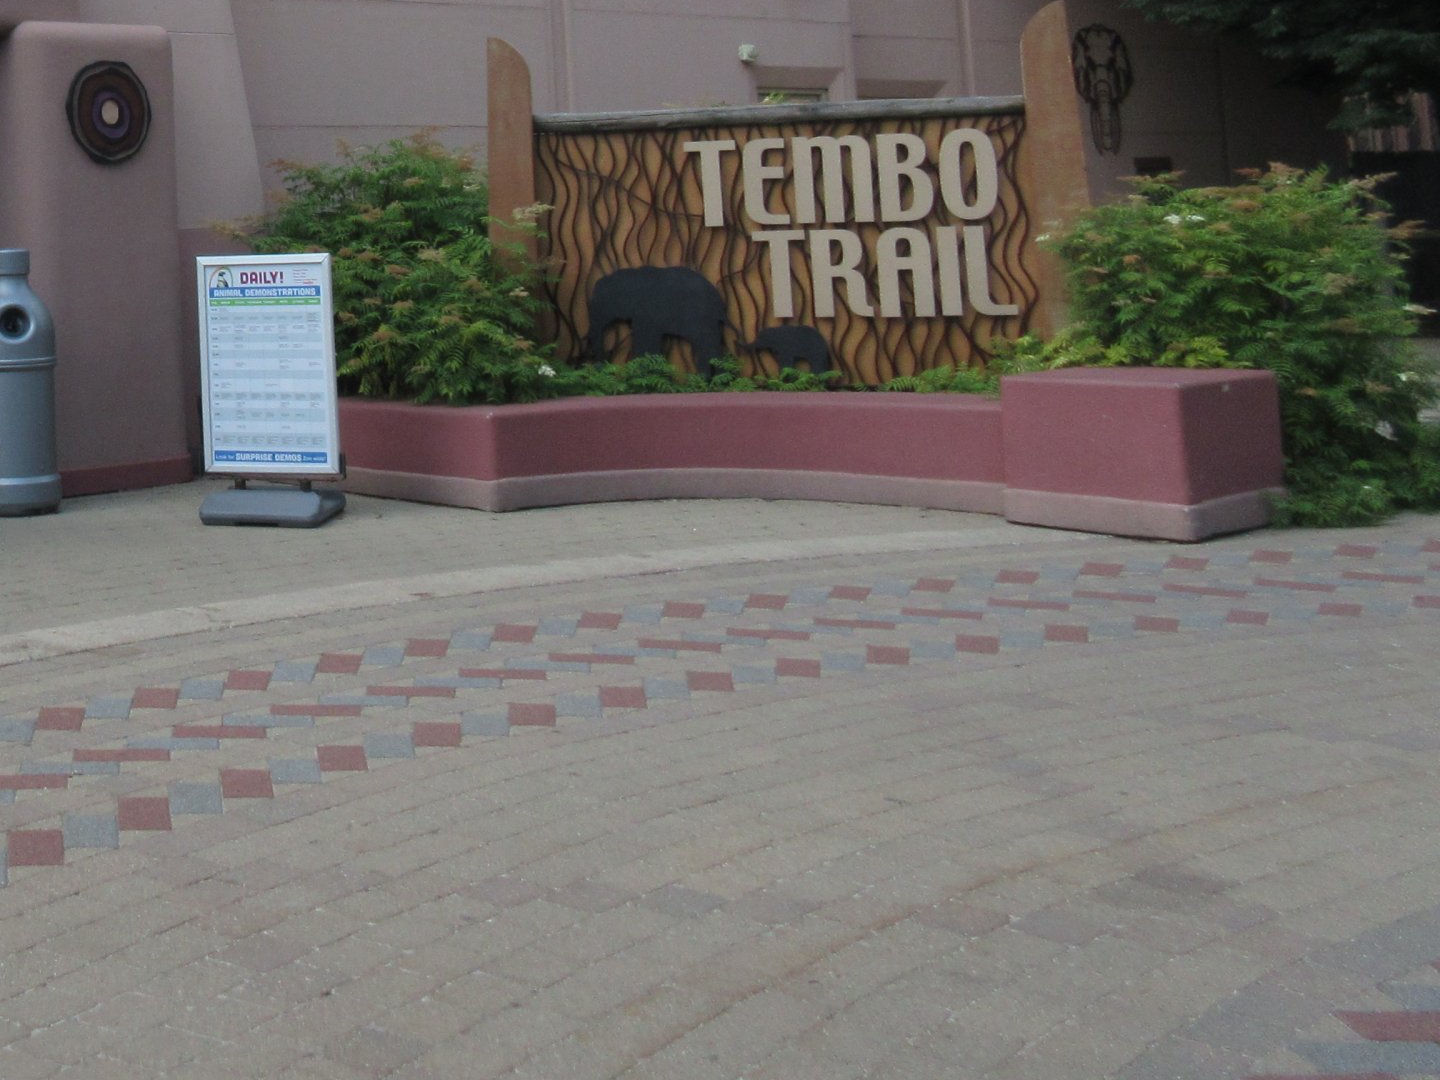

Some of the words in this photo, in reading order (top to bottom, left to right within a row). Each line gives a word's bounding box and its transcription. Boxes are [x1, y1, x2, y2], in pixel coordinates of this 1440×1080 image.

[684, 128, 998, 227] TEMBO
[752, 225, 1019, 318] TRAIL
[240, 272, 284, 284] DAILY!
[214, 288, 243, 297] ANIMAL
[245, 287, 316, 297] DEMONSTRATIONS
[235, 452, 273, 461] SURPRISE
[275, 453, 303, 462] DEMOS
